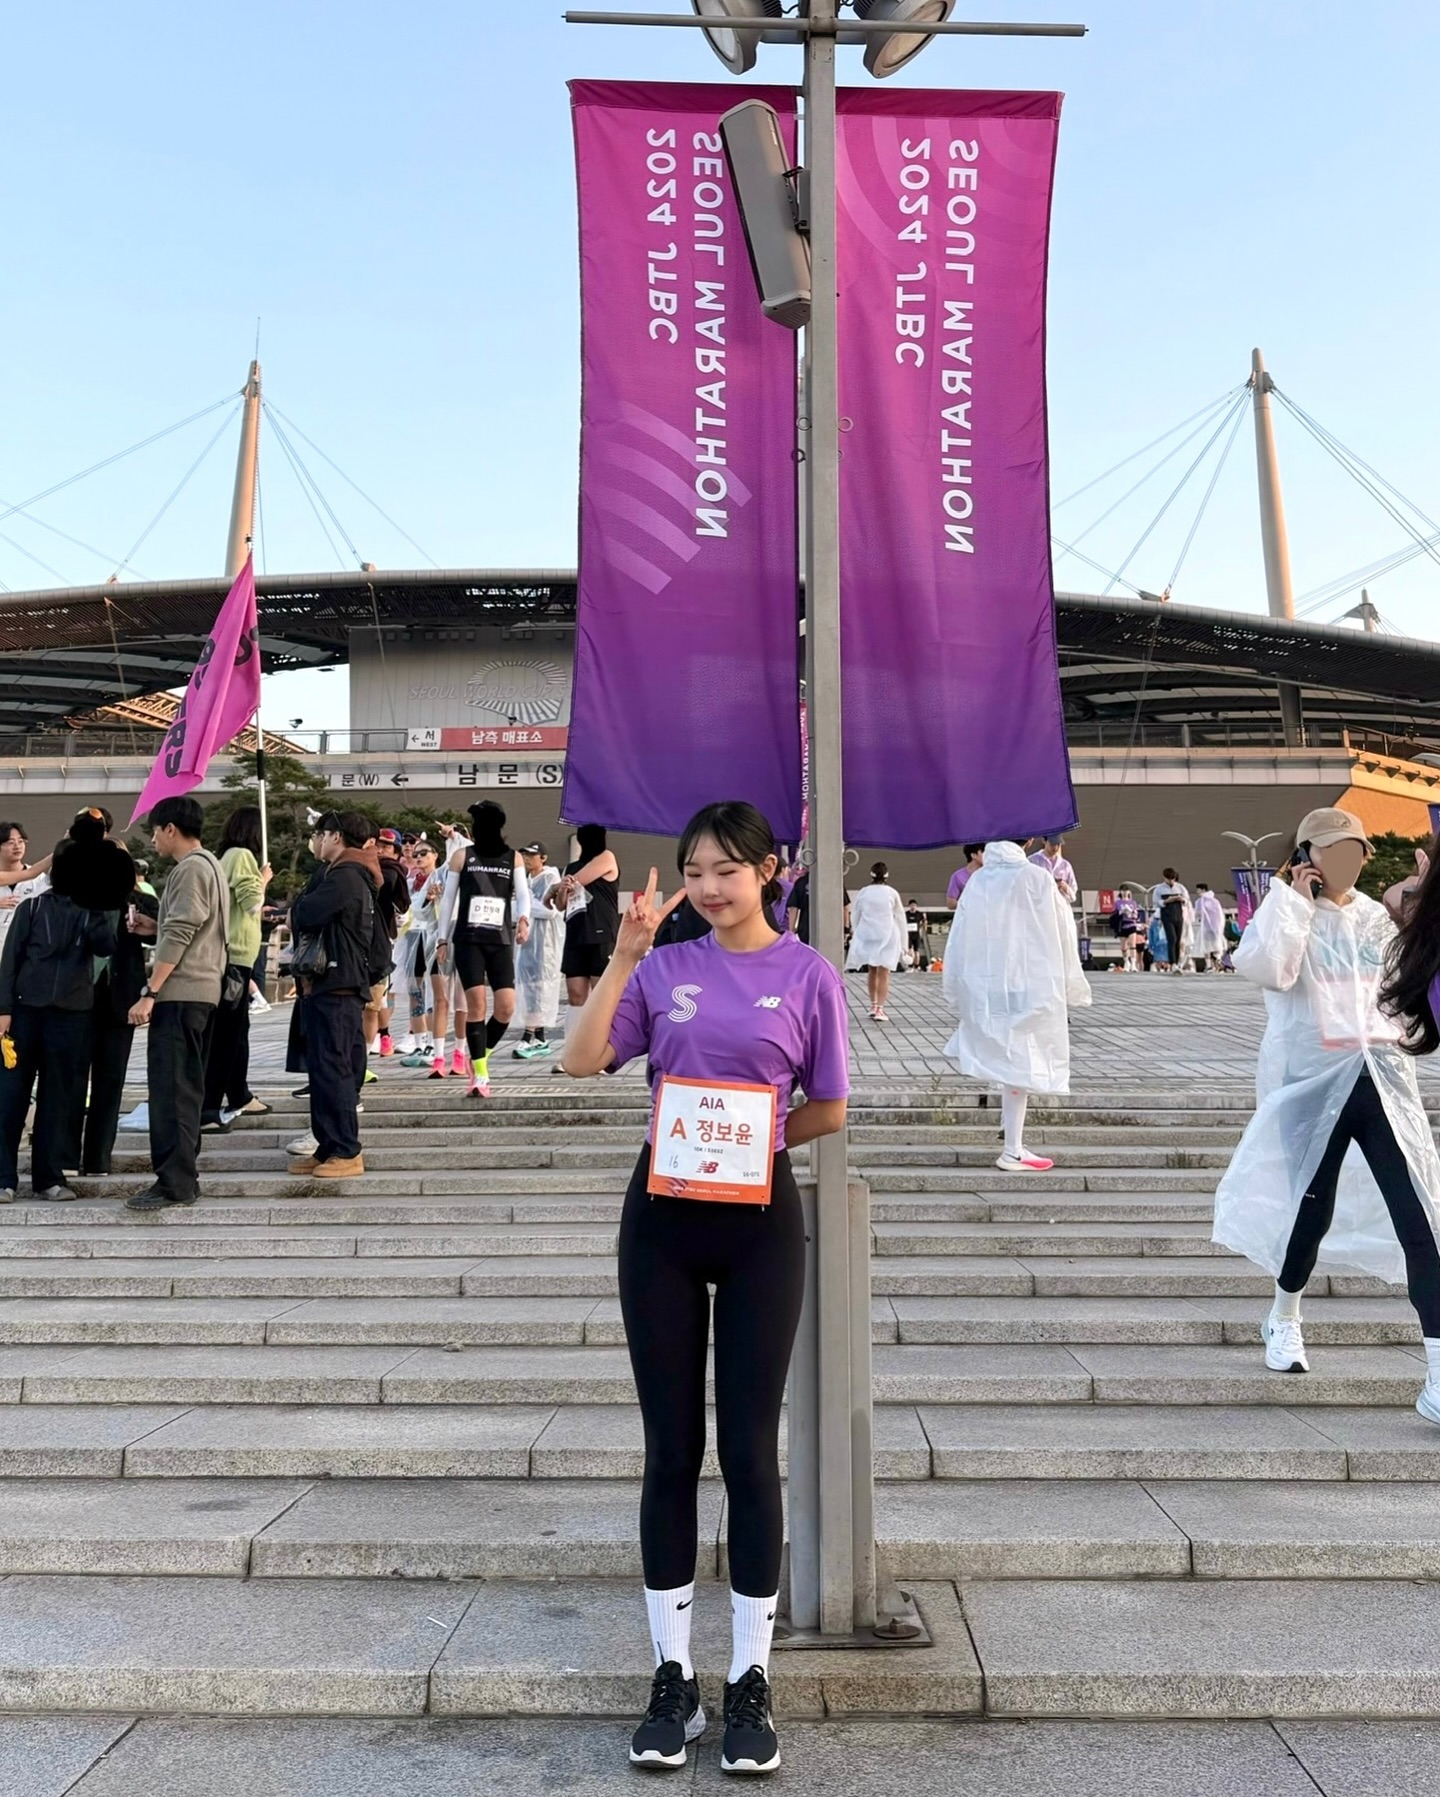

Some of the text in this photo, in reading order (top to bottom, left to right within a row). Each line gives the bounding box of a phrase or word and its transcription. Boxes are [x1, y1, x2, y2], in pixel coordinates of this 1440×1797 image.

[425, 730, 435, 740] 서
[472, 731, 543, 745] 남측 매표소
[699, 1096, 725, 1110] AIA
[670, 1117, 753, 1145] A 정보윤
